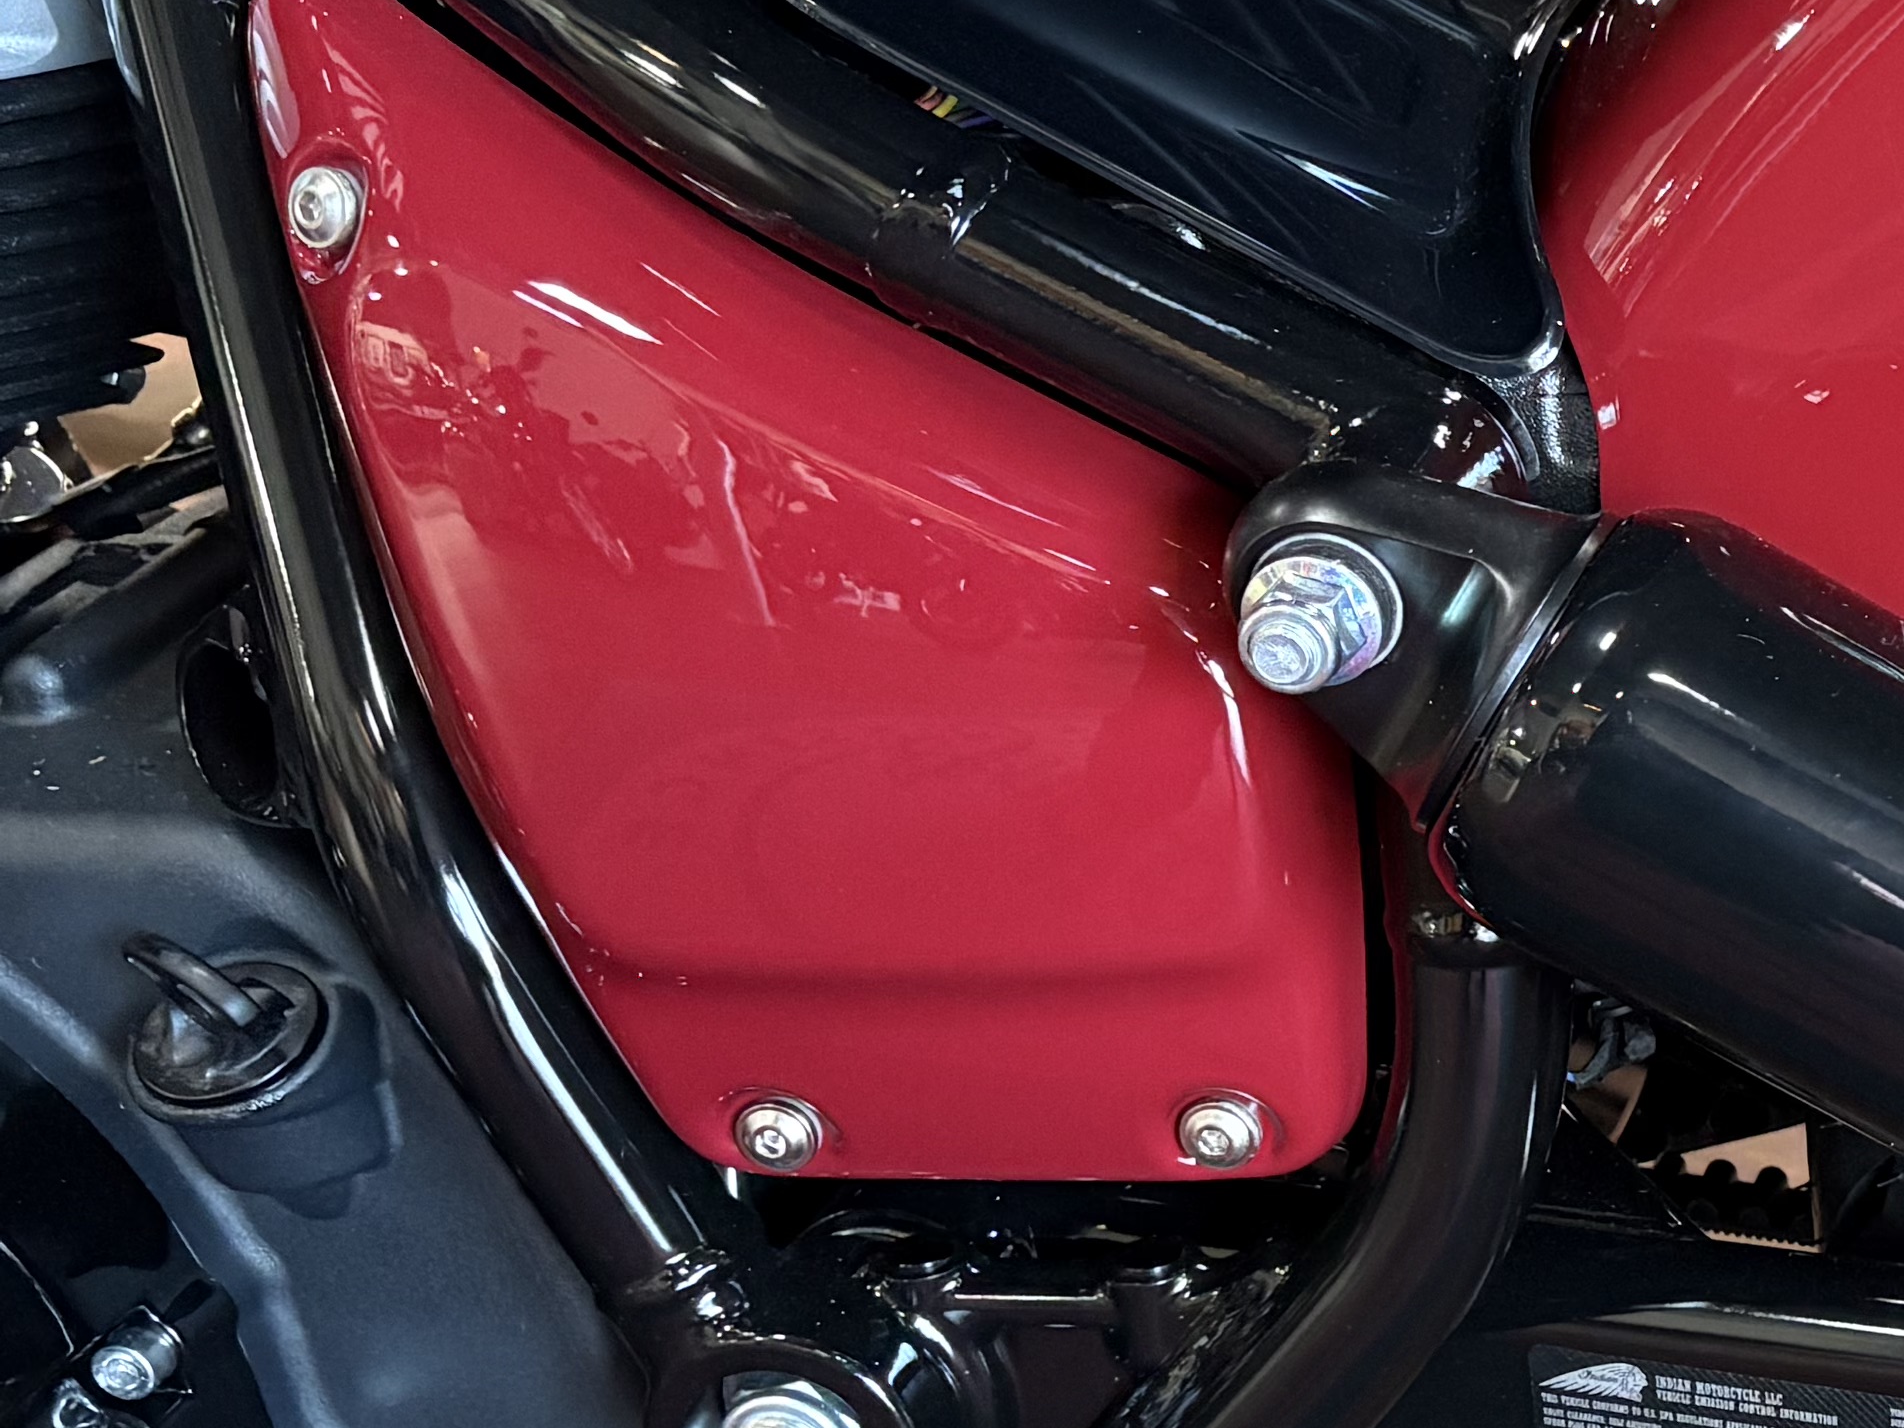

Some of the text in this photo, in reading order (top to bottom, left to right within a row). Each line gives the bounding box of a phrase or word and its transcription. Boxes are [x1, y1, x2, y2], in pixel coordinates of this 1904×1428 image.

[1655, 1374, 1782, 1406] INDIAN MOTORCYCLE LLC
[1655, 1389, 1837, 1427] VEHICLE EMISSION CONTROL INFORMATION
